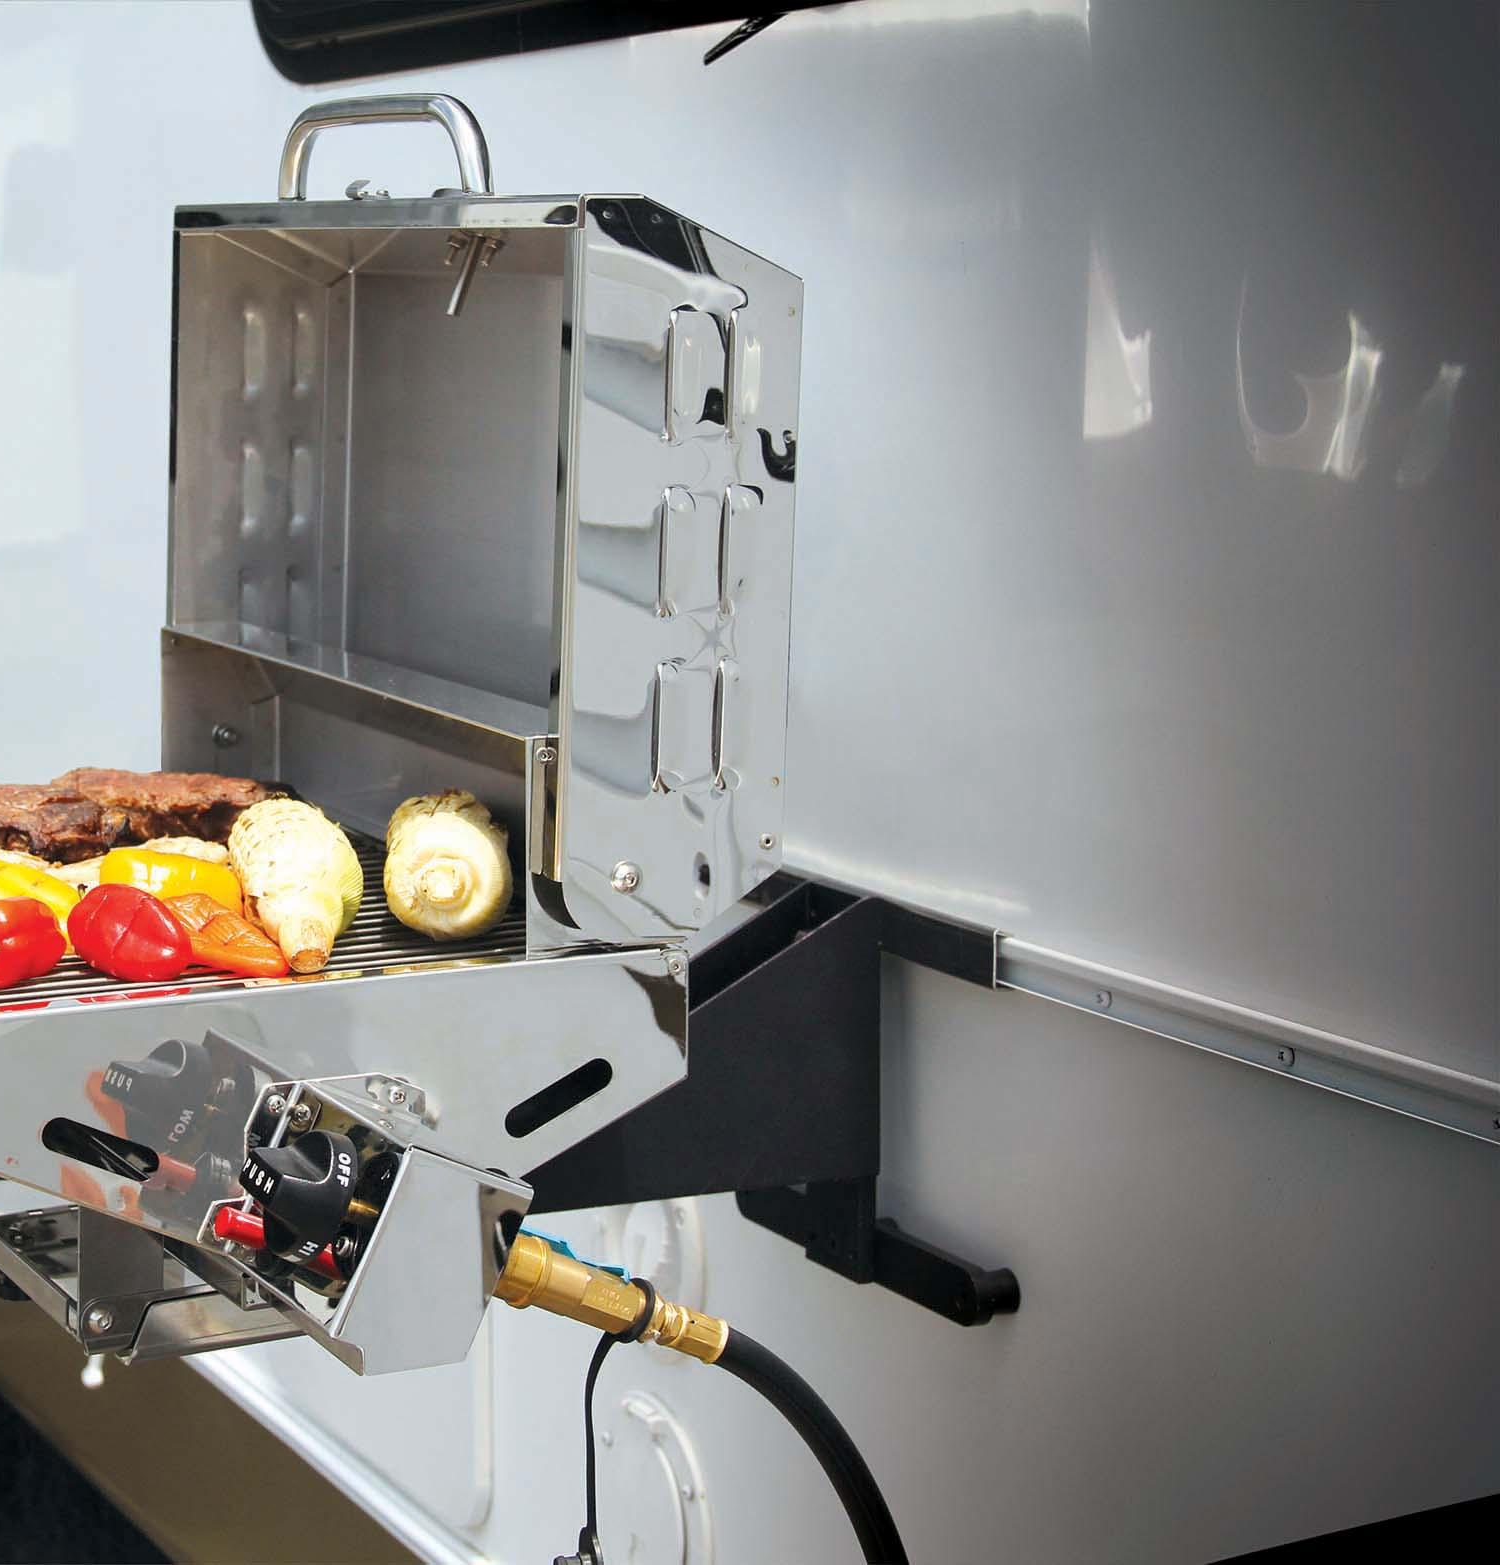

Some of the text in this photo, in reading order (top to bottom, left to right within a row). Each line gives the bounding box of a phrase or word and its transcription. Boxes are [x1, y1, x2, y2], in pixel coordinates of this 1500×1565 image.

[242, 1157, 275, 1195] PUSH
[336, 1152, 352, 1188] OFF
[298, 1240, 319, 1256] HI
